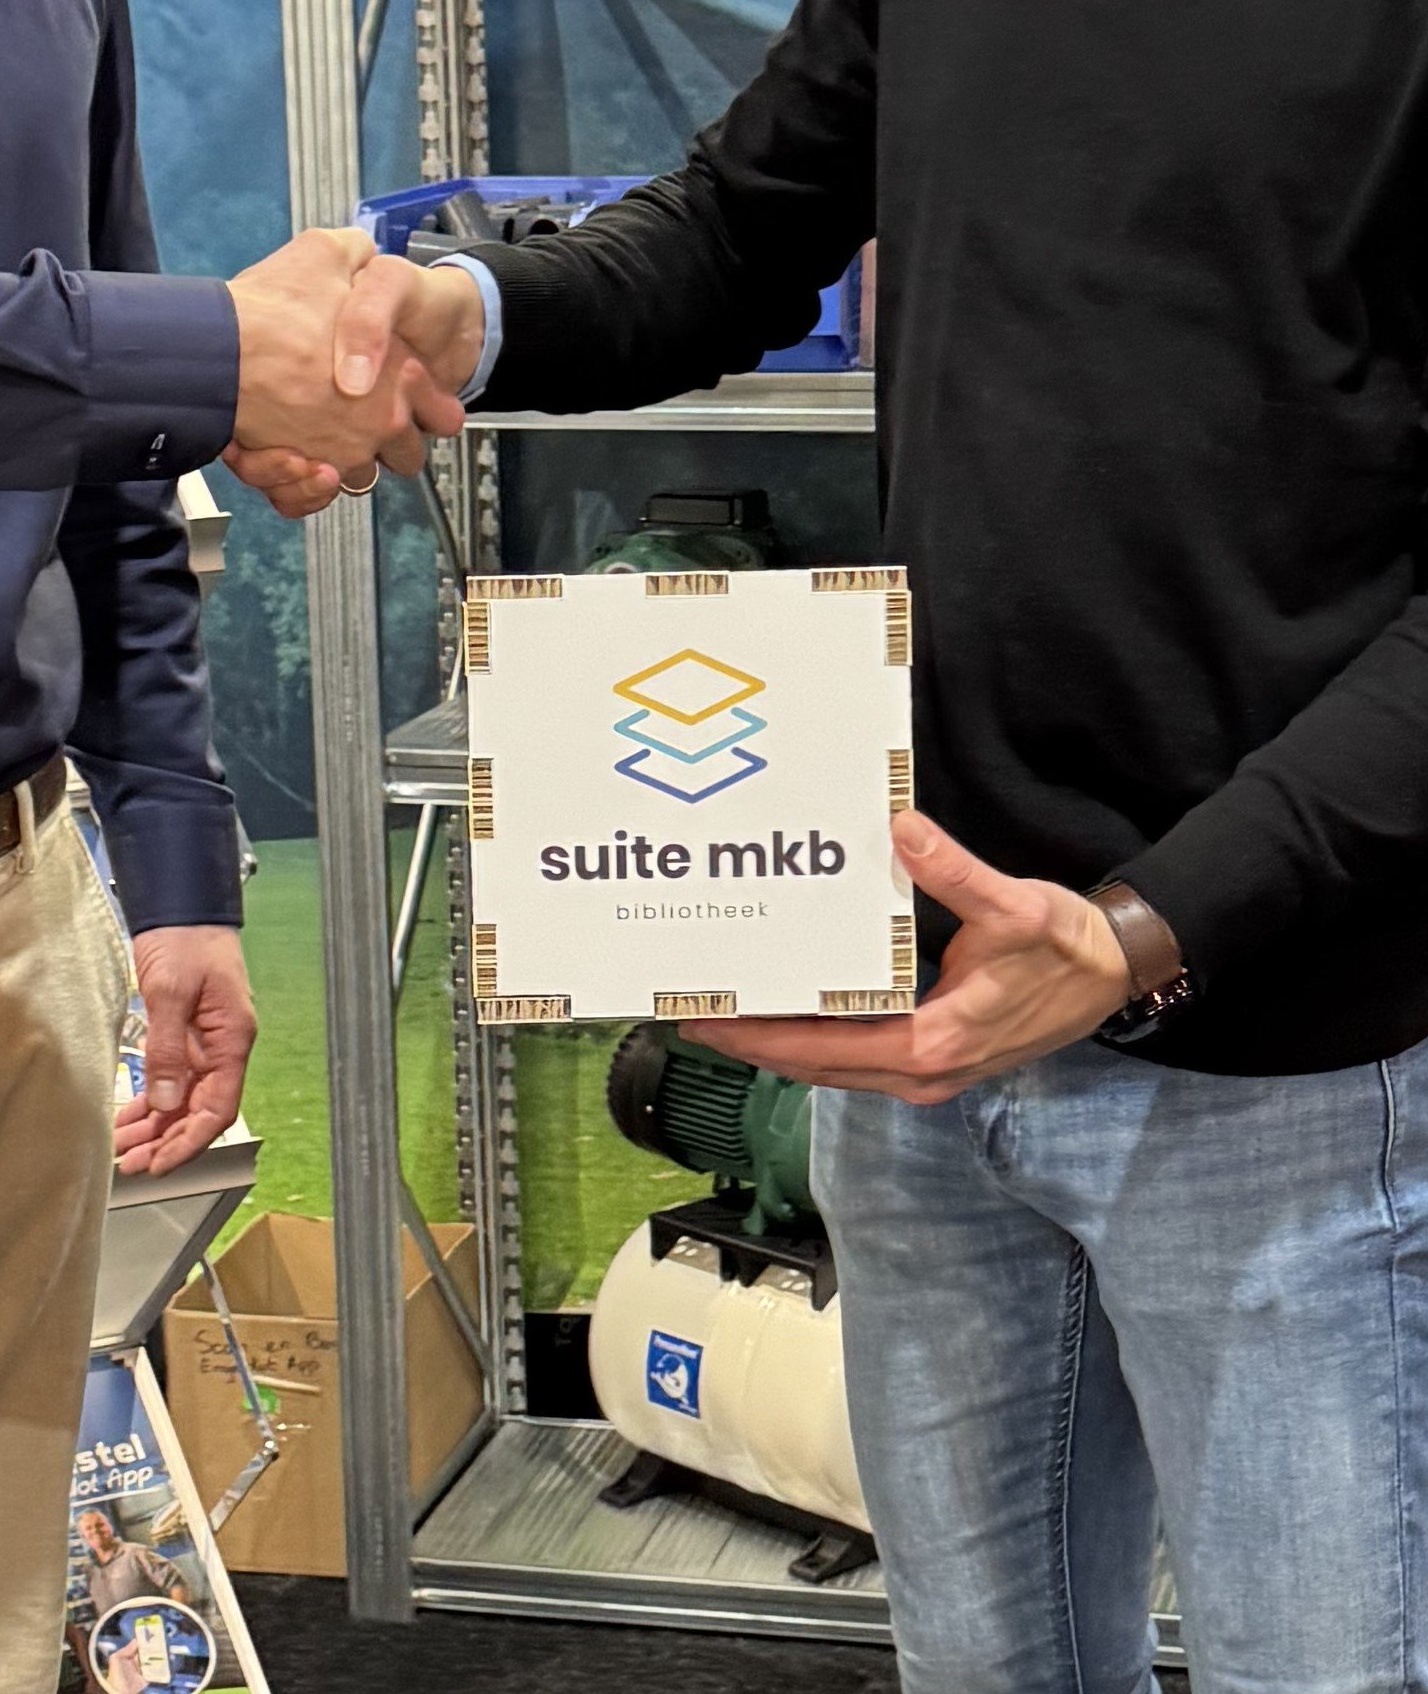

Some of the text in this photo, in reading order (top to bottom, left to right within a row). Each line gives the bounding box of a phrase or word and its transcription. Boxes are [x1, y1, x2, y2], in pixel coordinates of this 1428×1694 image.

[539, 830, 846, 881] suite mkb
[616, 901, 770, 921] bibliotheek
[106, 1466, 153, 1492] App
